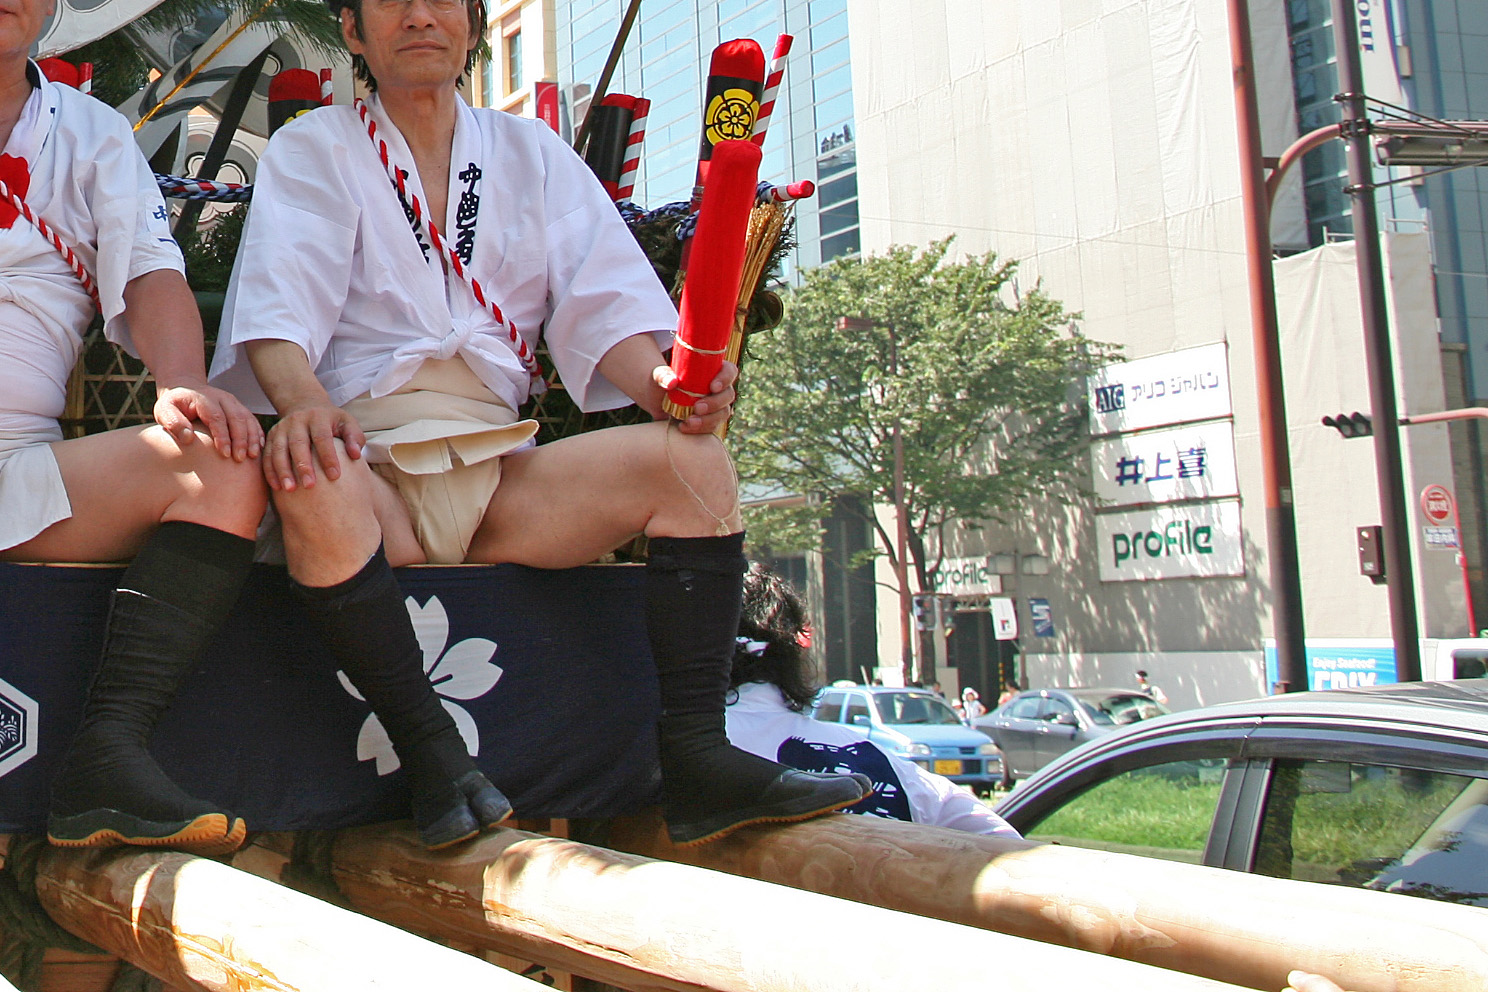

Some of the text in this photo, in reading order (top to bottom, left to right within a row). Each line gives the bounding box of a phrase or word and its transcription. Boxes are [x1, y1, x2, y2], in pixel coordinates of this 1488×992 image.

[1097, 385, 1124, 413] AIG
[1115, 447, 1207, 486] 井上喜
[1113, 519, 1213, 568] profile
